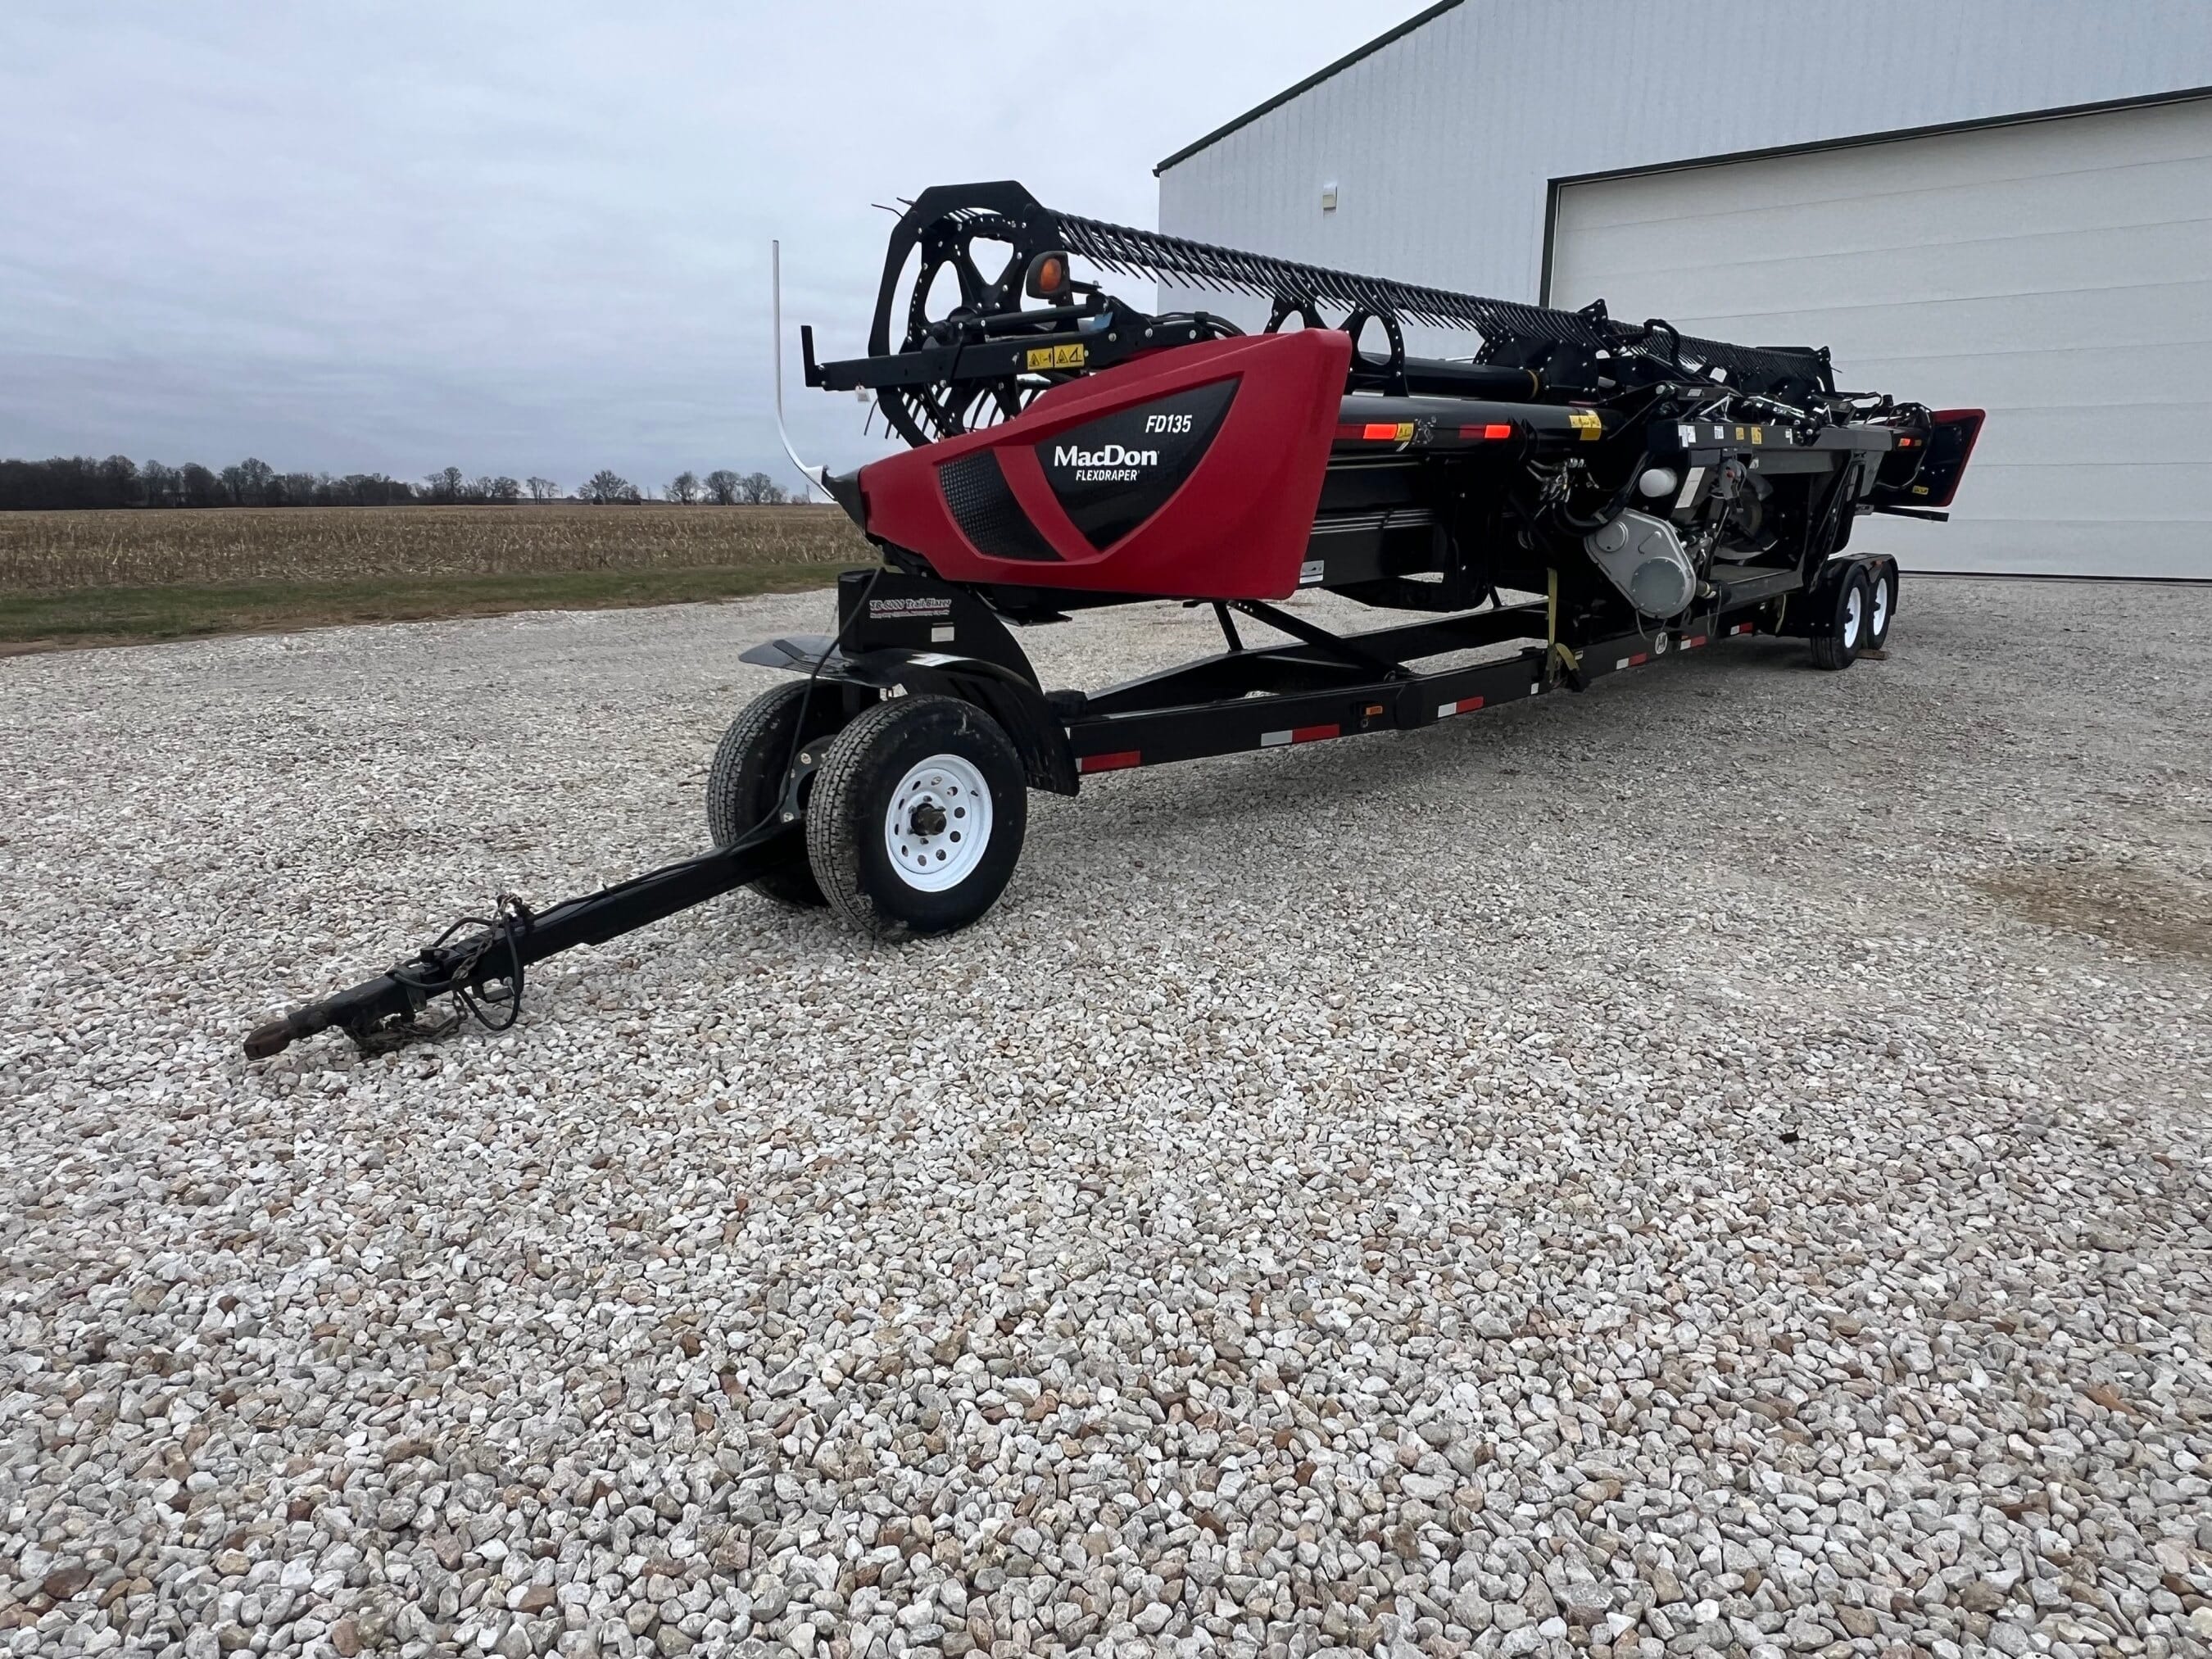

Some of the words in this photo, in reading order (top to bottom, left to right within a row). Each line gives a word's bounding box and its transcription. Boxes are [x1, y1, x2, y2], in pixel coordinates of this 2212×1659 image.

[1145, 414, 1193, 433] FD135
[1054, 444, 1158, 467] MacDon
[1076, 469, 1138, 482] FLEXDRAPER
